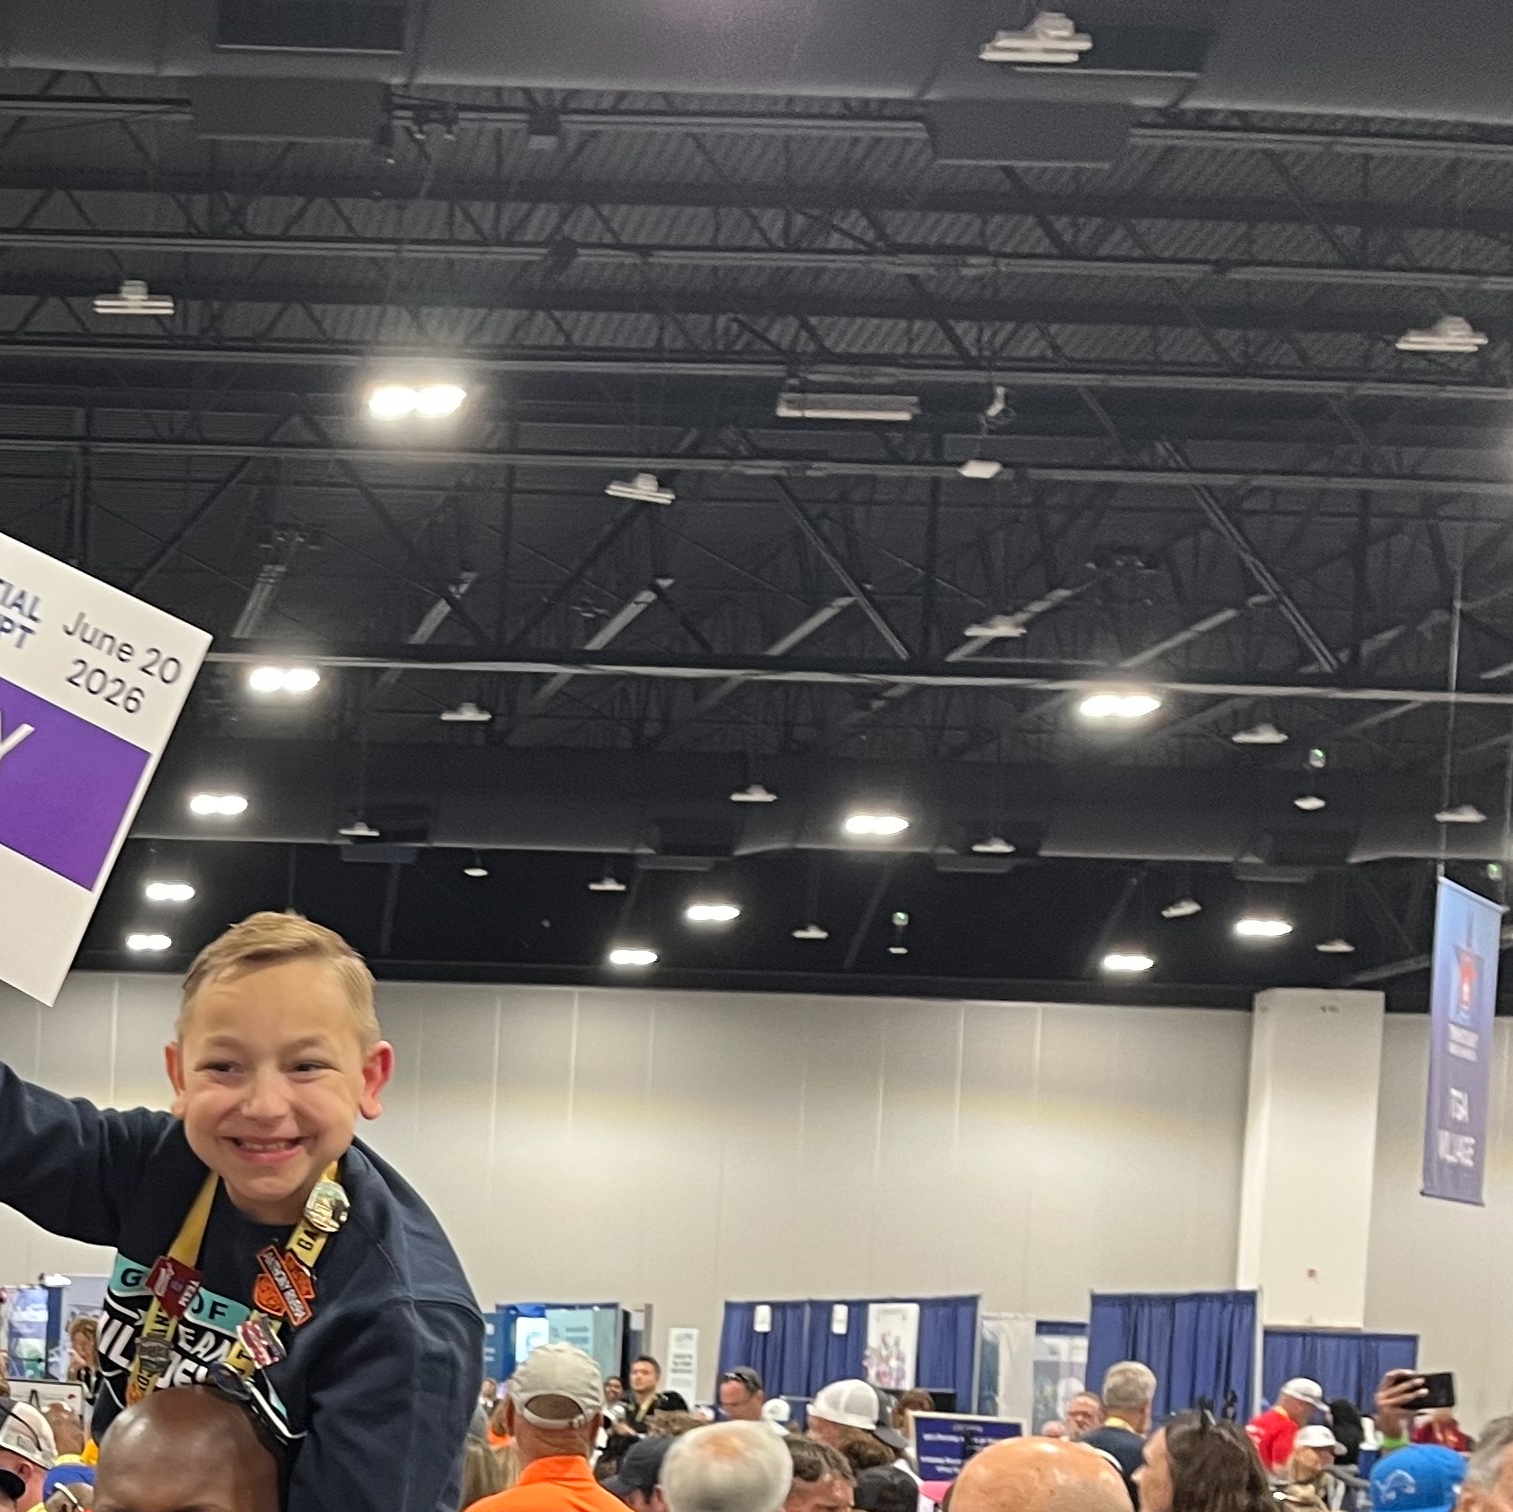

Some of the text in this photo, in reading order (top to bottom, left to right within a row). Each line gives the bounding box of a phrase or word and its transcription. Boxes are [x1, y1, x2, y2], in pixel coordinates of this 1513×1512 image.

[62, 611, 183, 685] June 20
[65, 658, 146, 714] 2026
